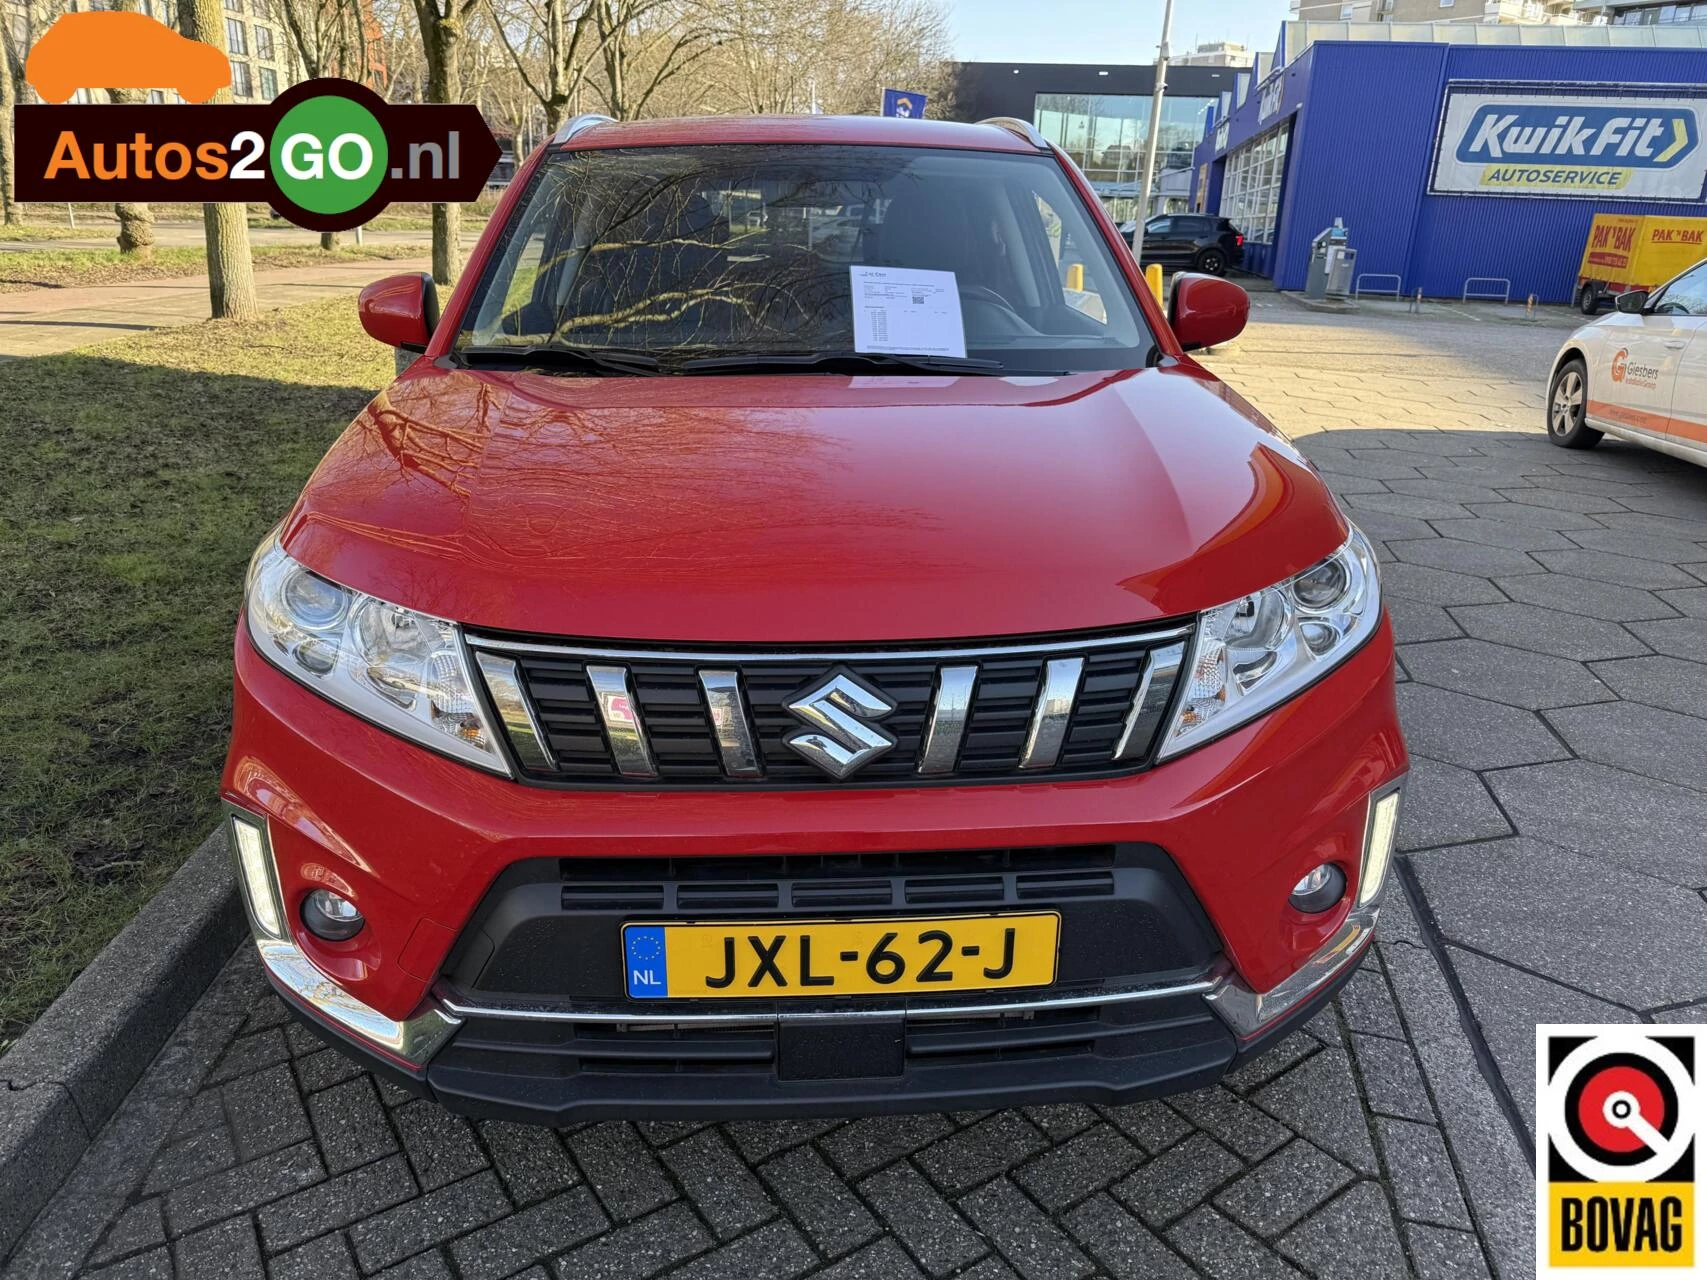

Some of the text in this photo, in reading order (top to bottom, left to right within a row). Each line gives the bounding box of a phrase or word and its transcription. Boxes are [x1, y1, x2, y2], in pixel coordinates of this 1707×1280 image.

[1488, 168, 1622, 186] AUTOSERVICE
[1627, 361, 1659, 380] Giesbers
[633, 928, 1016, 989] NL JXL-62-J
